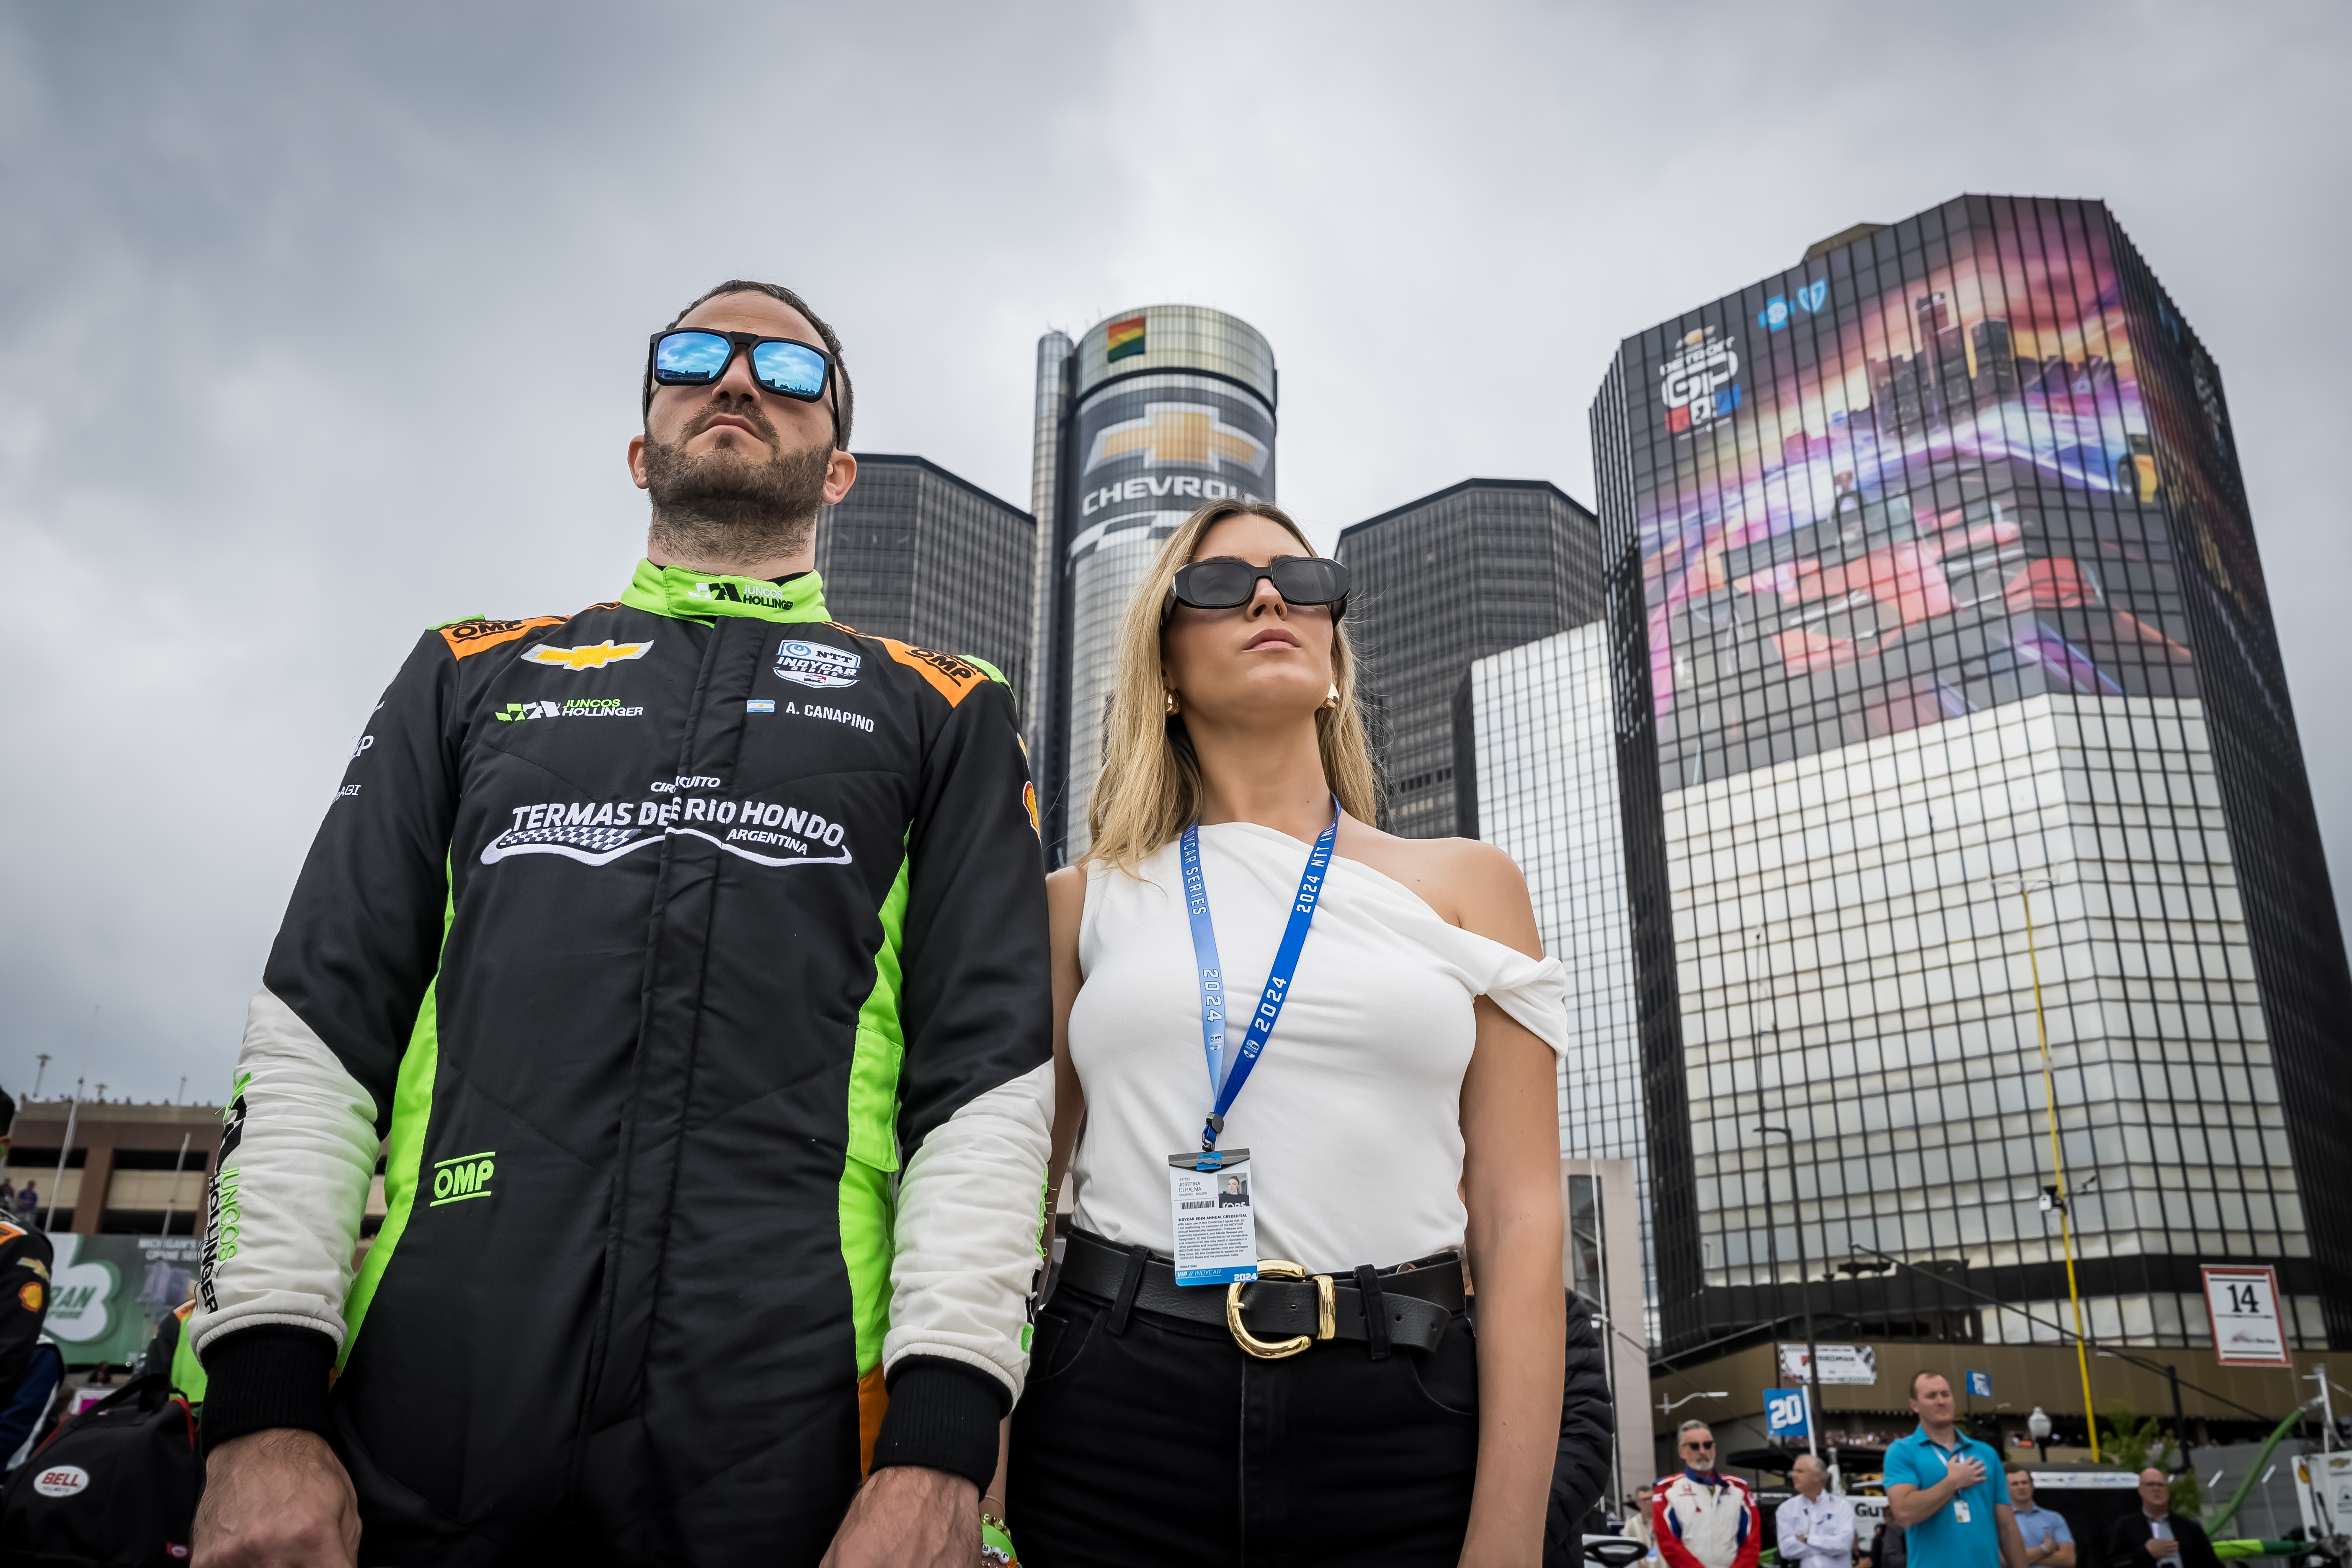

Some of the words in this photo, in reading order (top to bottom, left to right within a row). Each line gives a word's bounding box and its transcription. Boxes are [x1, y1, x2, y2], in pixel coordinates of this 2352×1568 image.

[1082, 475, 1259, 516] CHEVRO
[743, 585, 783, 599] JUNCOS
[776, 656, 857, 676] INDYCAR
[791, 666, 838, 676] SERIES
[815, 650, 852, 663] NTT
[911, 650, 972, 679] OMP
[562, 707, 644, 717] HOLLINGER
[563, 699, 621, 708] JUNCOS
[785, 701, 800, 715] A.
[804, 704, 874, 732] CANAPINO
[650, 776, 721, 793] CIRCUITO
[512, 802, 634, 831] TERMAS
[741, 801, 845, 846] HONDO
[726, 828, 808, 856] ARGENTINA
[1185, 866, 1207, 916] SERIES
[1296, 875, 1320, 913] 2024
[1310, 846, 1330, 867] NTT
[1202, 968, 1223, 1023] 2024
[1255, 976, 1287, 1033] 2024
[434, 1160, 494, 1199] OMP
[218, 1167, 240, 1262] JUNCOS
[1234, 1272, 1258, 1282] 2024
[2226, 1283, 2259, 1313] 14
[1769, 1394, 1803, 1430] 20
[41, 1472, 78, 1487] BELL
